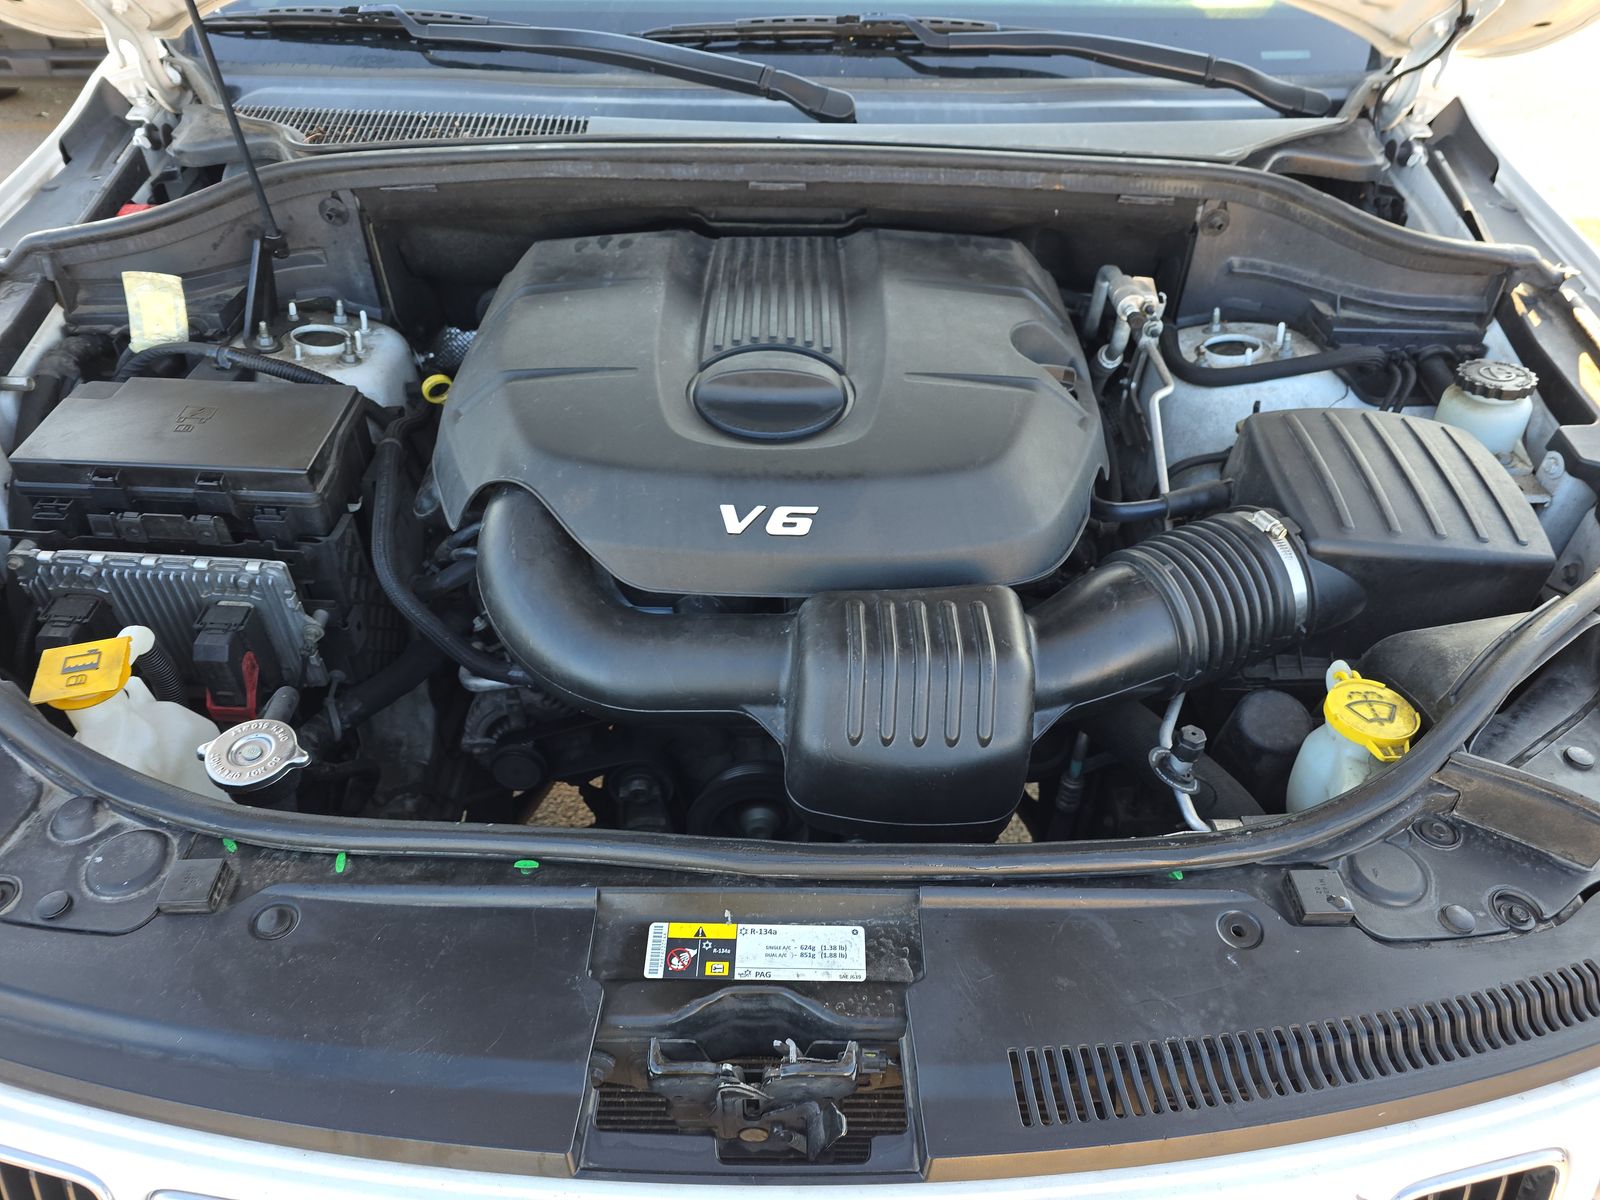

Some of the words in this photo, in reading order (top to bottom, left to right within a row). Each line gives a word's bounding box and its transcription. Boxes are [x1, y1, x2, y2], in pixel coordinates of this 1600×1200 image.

[720, 504, 819, 536] V6
[750, 928, 777, 936] R-134a
[800, 944, 816, 952] 624g
[820, 944, 837, 952] (1.38
[838, 944, 848, 952] lb)
[820, 952, 837, 960] (1.88
[838, 952, 848, 960] lb)
